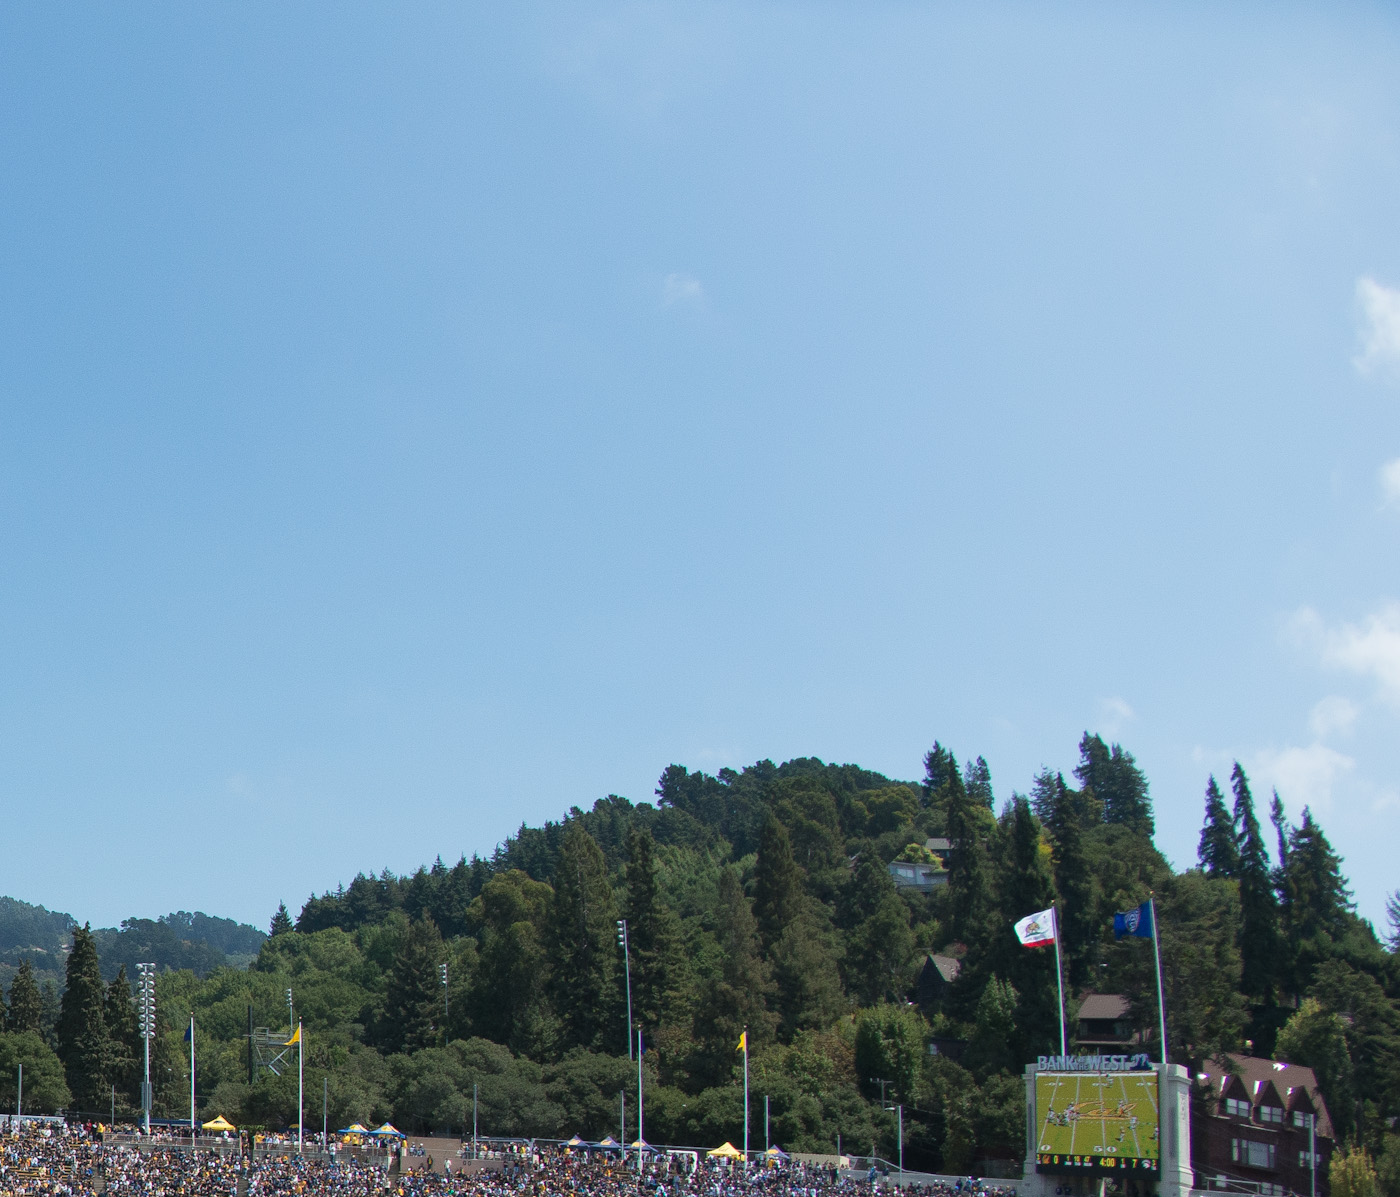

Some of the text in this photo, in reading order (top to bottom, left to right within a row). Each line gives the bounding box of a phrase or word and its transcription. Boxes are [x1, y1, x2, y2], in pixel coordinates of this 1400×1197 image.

[1037, 1055, 1076, 1071] BANK
[1088, 1055, 1128, 1071] WEST
[1093, 1145, 1117, 1153] 50
[1100, 1158, 1116, 1167] 4:00
[1132, 1159, 1138, 1168] 7
